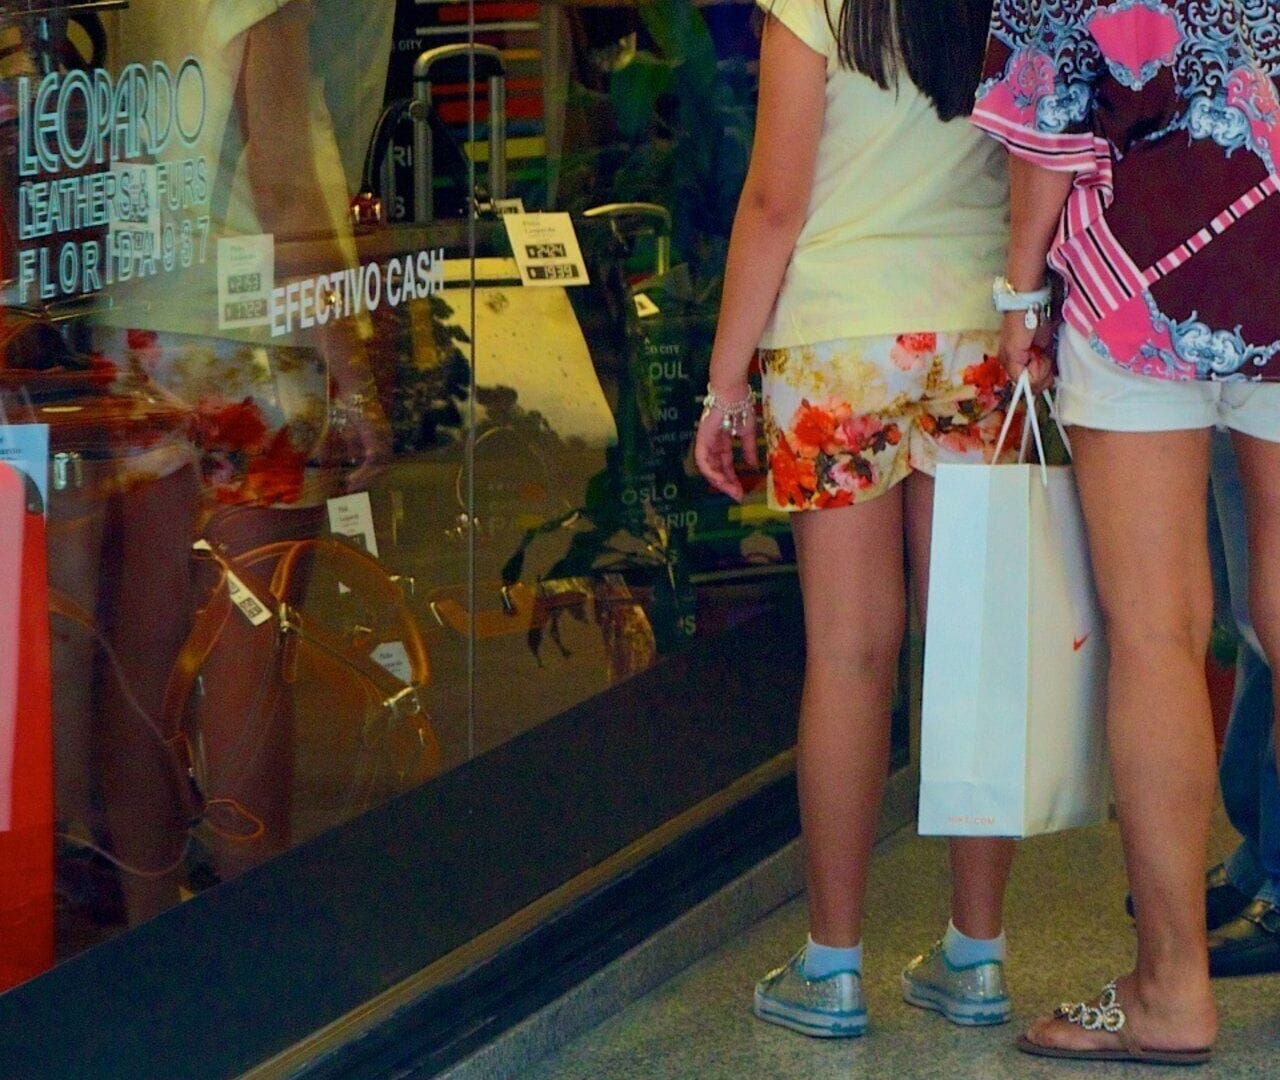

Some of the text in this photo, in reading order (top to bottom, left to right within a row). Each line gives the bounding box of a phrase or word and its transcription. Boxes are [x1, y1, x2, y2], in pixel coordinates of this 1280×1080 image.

[17, 55, 207, 177] LEOPARDO
[155, 156, 208, 212] FURS
[18, 216, 210, 305] FLORIDA 937
[269, 248, 445, 338] EFECTIVO CASH
